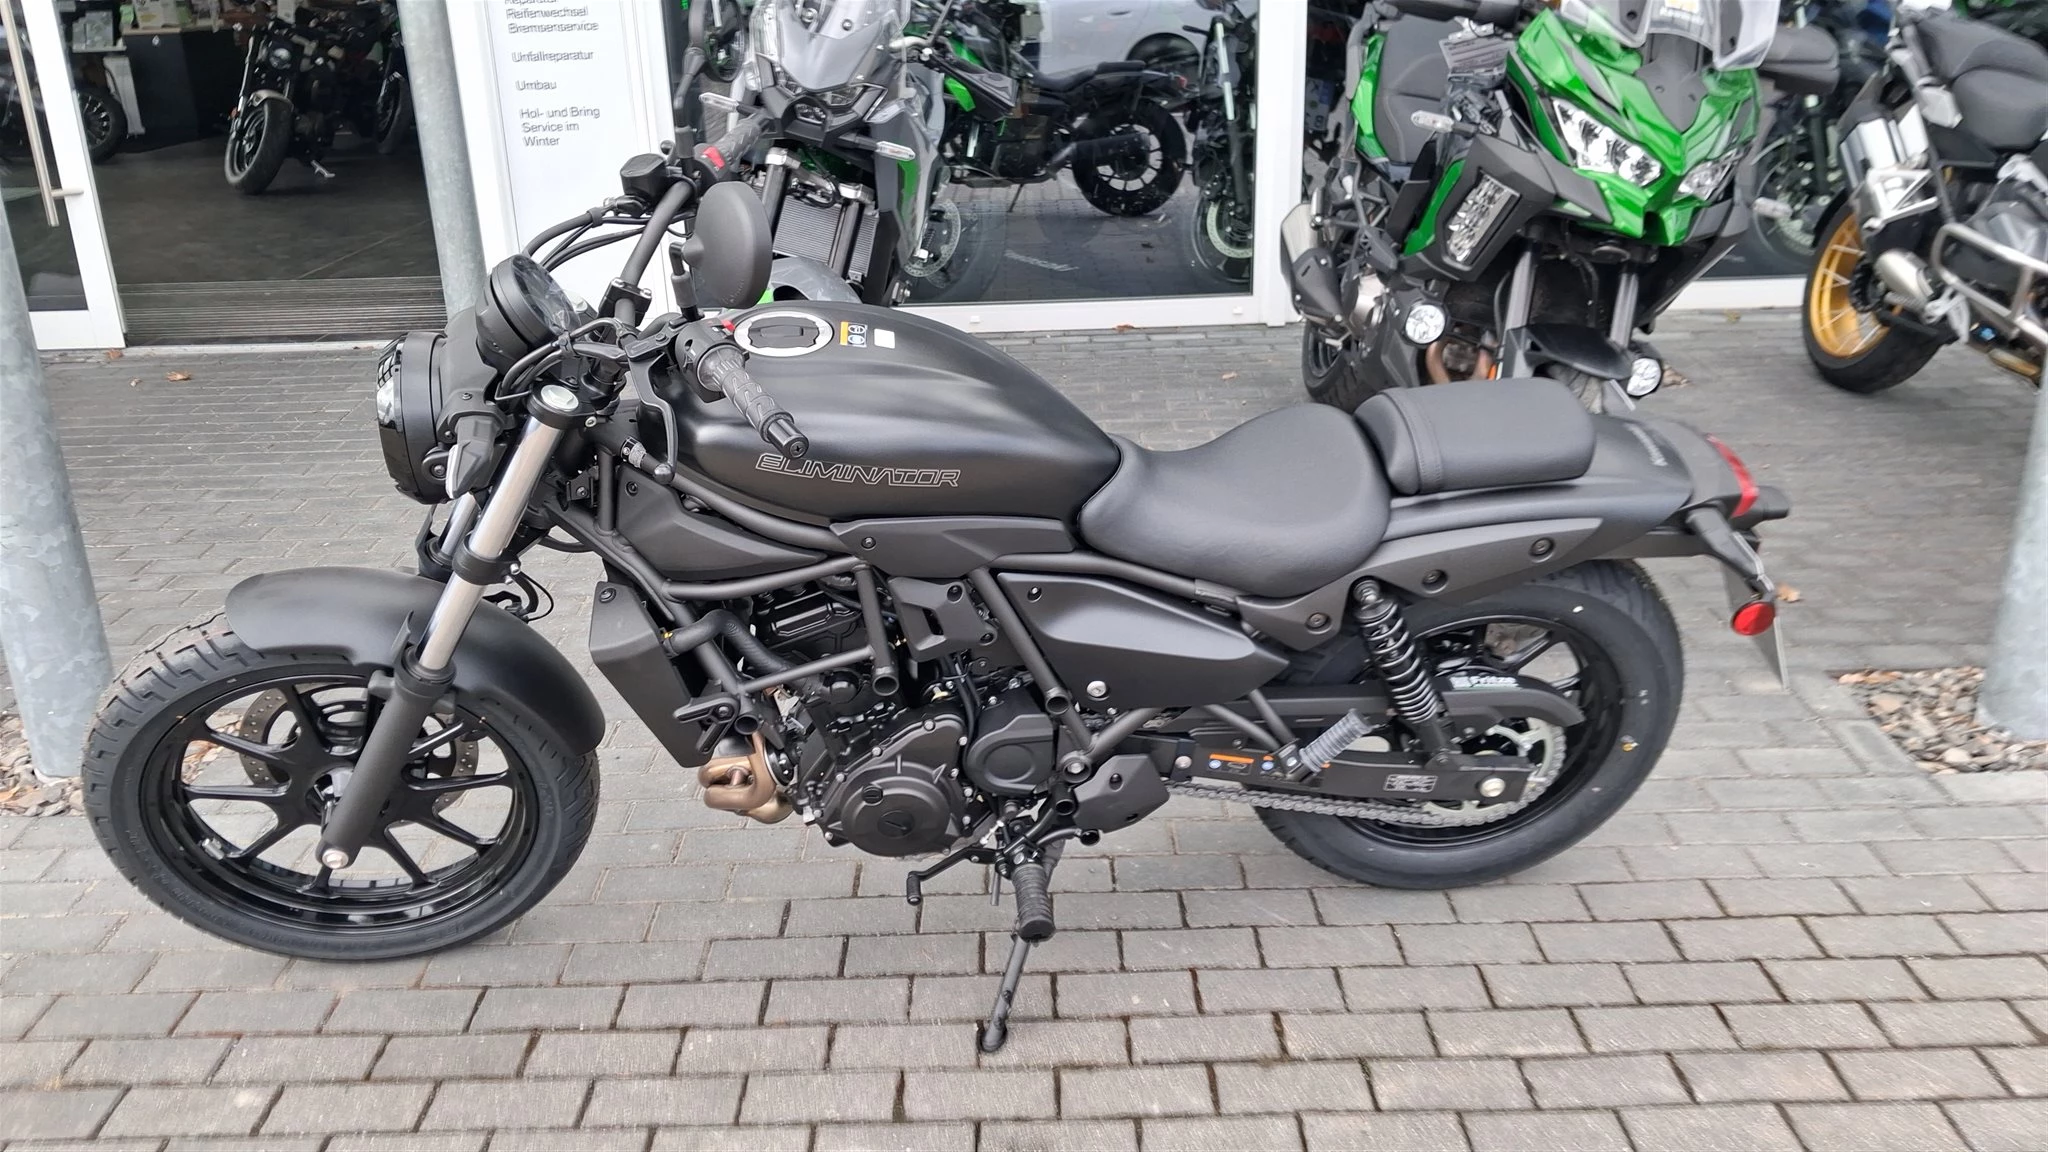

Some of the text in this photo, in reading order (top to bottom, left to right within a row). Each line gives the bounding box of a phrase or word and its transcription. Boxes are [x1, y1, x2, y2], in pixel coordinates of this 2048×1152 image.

[506, 6, 588, 19] Reifenwechsel
[508, 21, 599, 33] Bremsenservice
[512, 51, 594, 63] Unfallreparatur
[516, 80, 557, 91] Umbau
[520, 106, 600, 119] Hol- und Bring
[522, 121, 579, 133] Service im
[523, 136, 560, 147] Winter
[755, 453, 961, 487] ELIMINATOR
